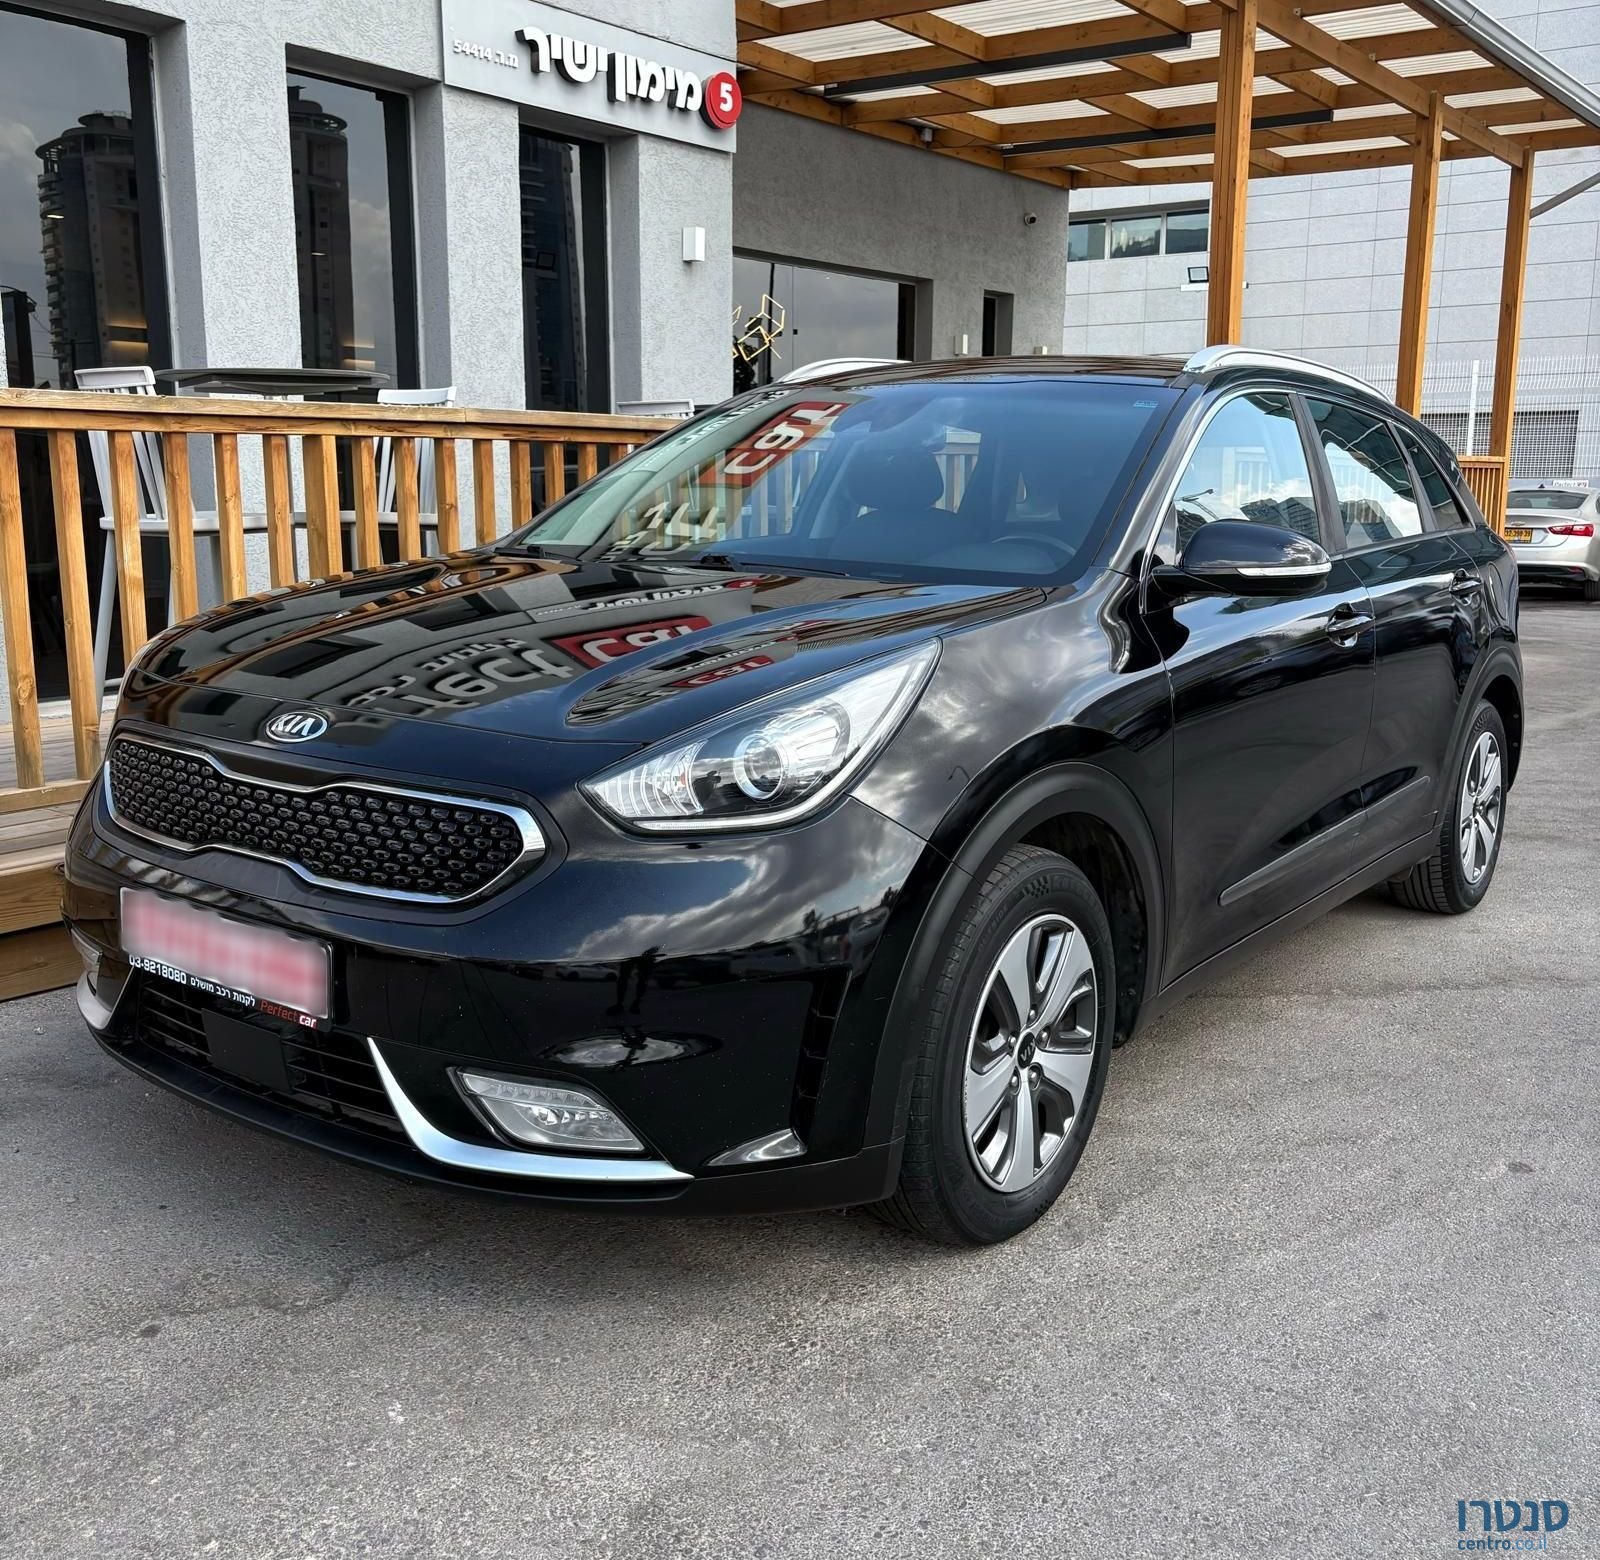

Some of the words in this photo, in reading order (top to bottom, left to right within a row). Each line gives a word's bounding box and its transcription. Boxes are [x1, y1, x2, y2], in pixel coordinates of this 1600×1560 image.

[453, 39, 492, 62] 54414
[518, 26, 608, 83] ישיר
[608, 53, 702, 111] מימון
[719, 83, 733, 112] 5
[271, 714, 316, 737] KIA
[129, 954, 187, 985] 03-9218080
[190, 976, 215, 993] מושלם
[216, 986, 231, 999] רכב
[233, 991, 256, 1007] לקנות
[260, 1000, 298, 1022] Perfect
[299, 1014, 317, 1027] car
